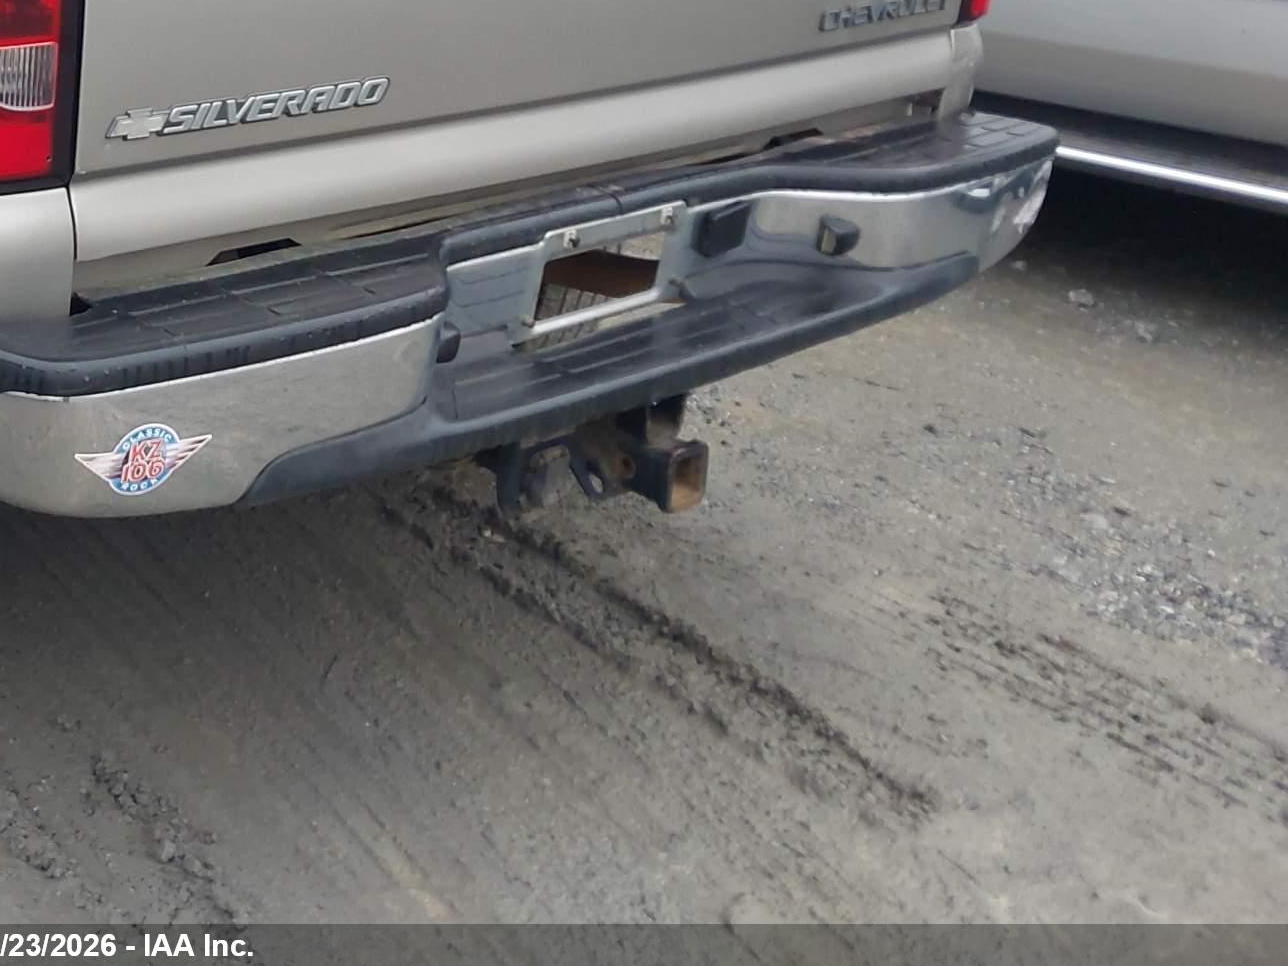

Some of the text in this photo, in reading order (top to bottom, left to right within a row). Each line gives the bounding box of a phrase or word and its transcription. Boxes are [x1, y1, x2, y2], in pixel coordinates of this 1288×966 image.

[160, 76, 390, 136] SILVERADO
[121, 427, 173, 451] CLASSIC
[129, 437, 165, 464] KZ
[120, 457, 166, 483] 106
[120, 477, 160, 492] ROCK
